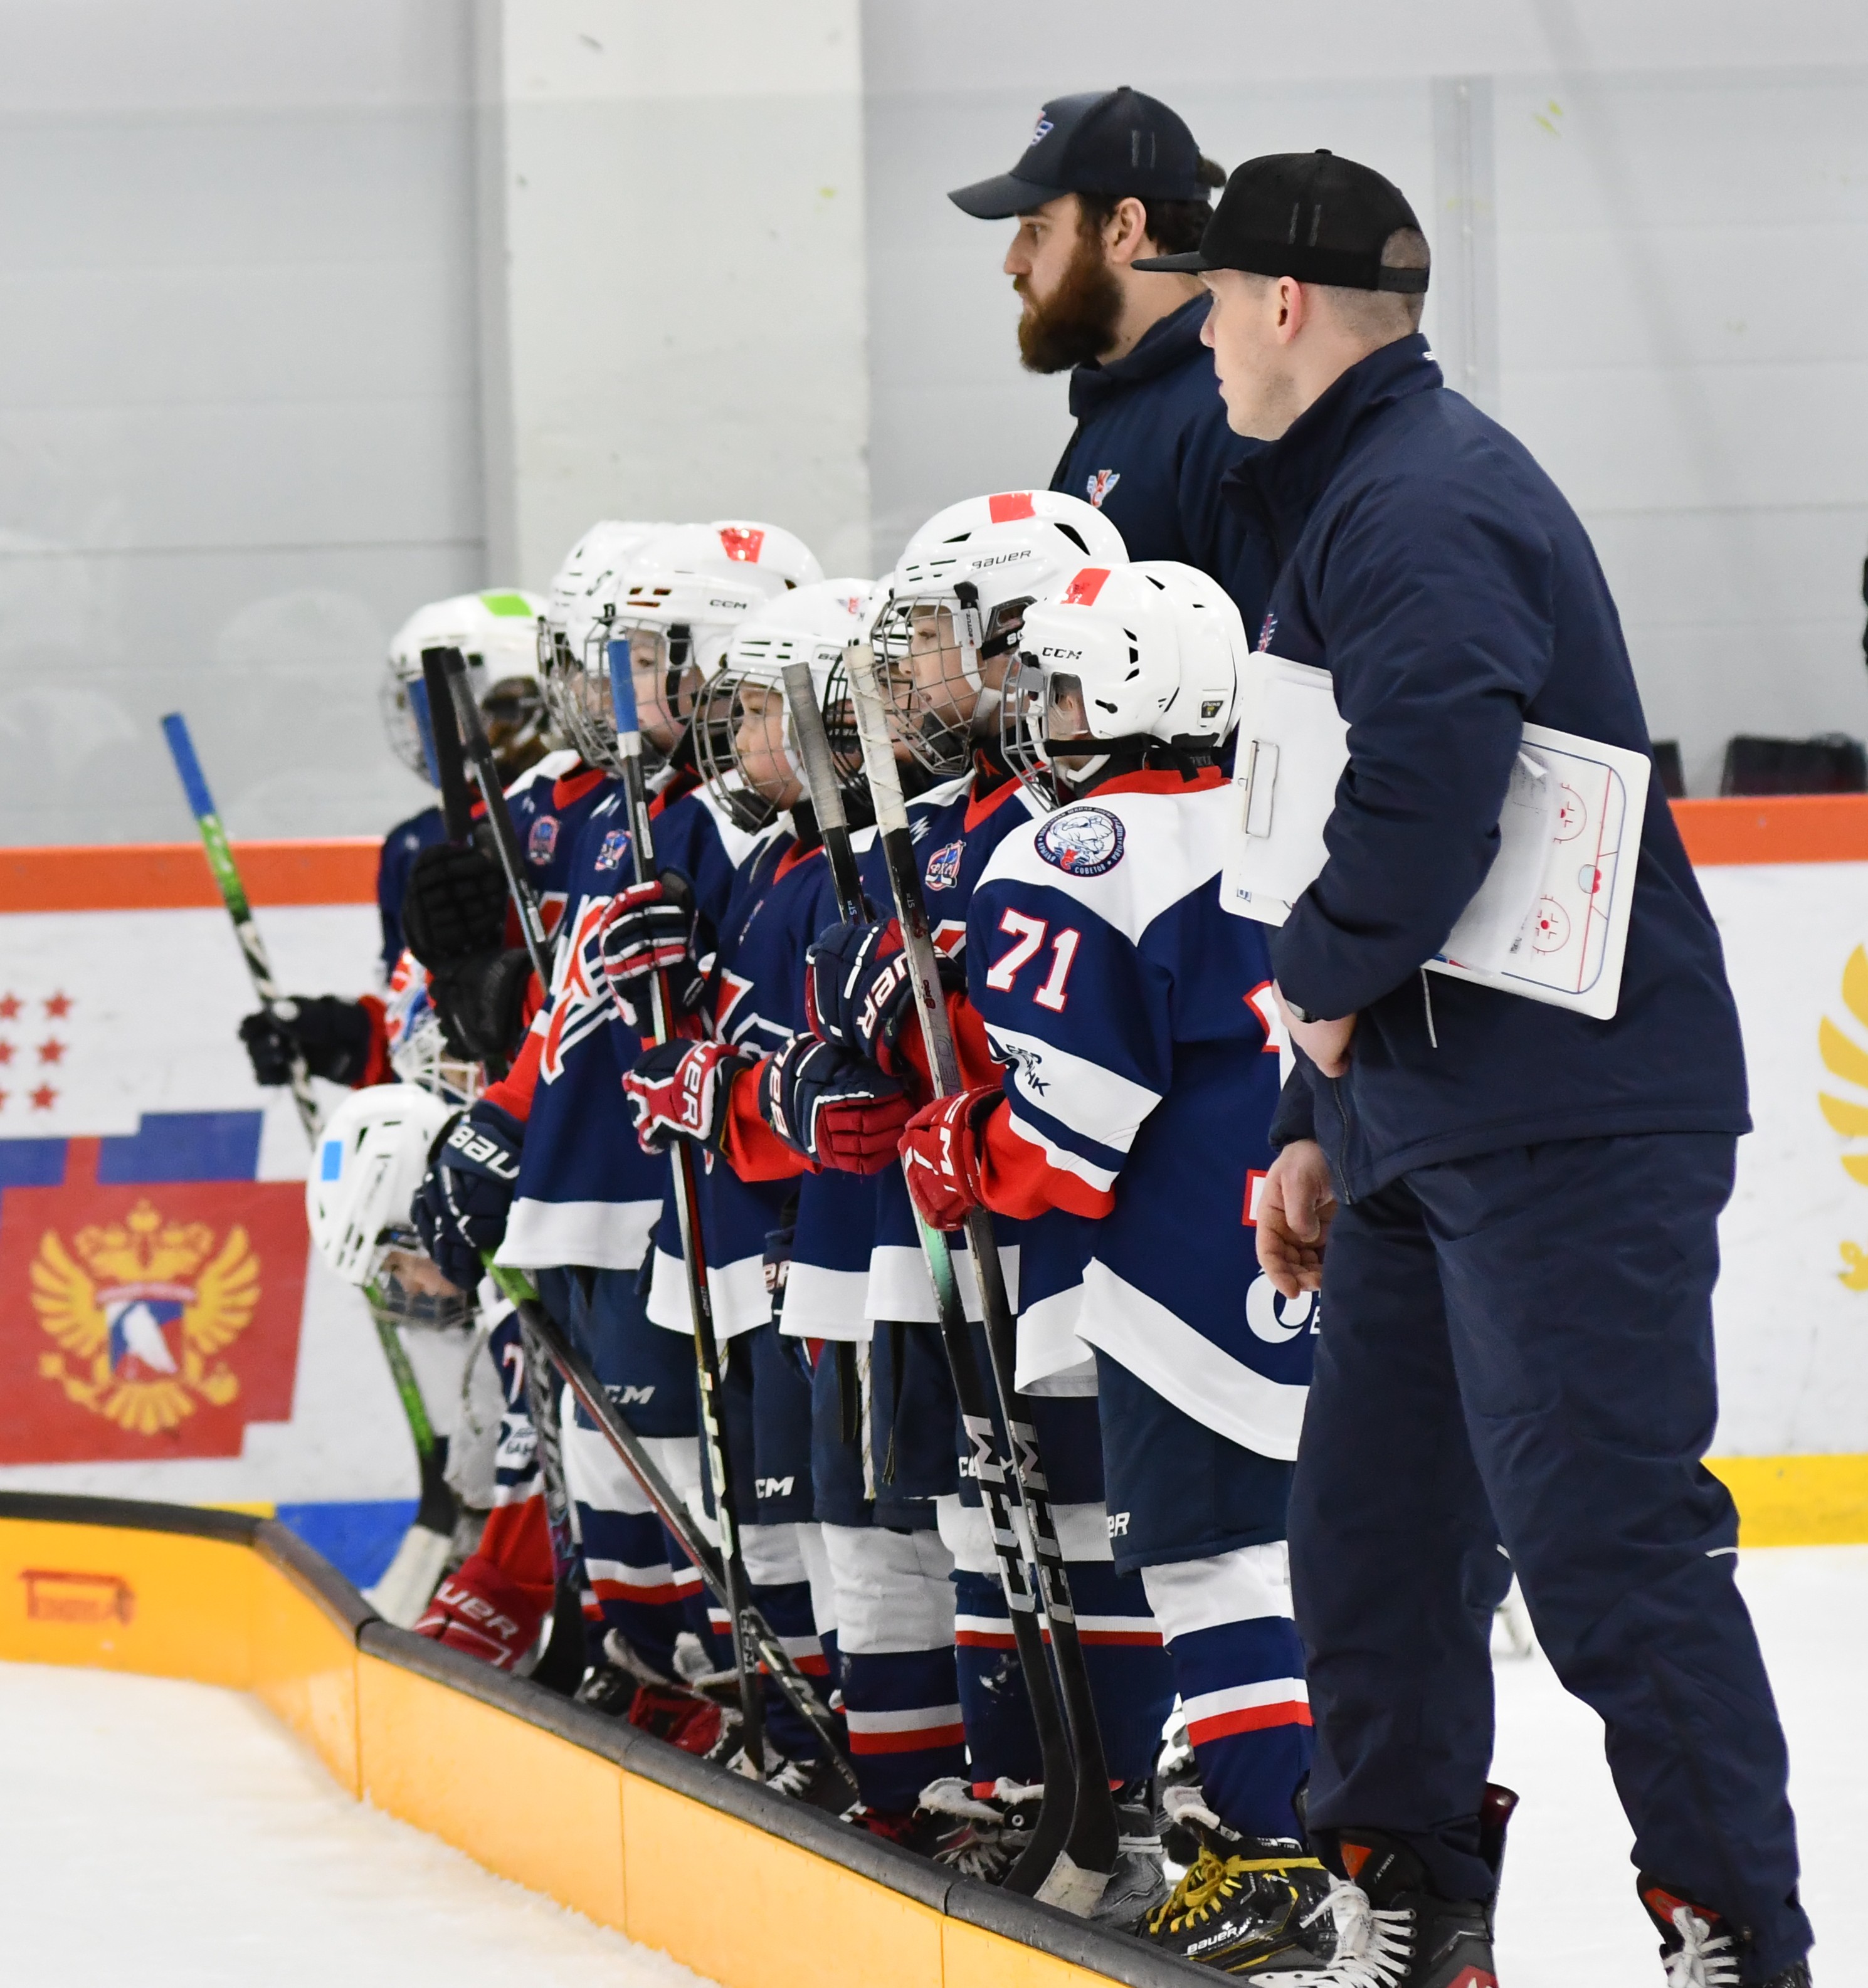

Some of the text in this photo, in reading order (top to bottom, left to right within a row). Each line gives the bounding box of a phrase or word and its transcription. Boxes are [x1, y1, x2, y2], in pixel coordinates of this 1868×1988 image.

[971, 550, 1032, 571] BAUER
[710, 599, 747, 610] CCM
[1042, 646, 1082, 660] CCM
[1074, 864, 1106, 875] СОВЕТОВ
[986, 907, 1082, 1014] 71
[962, 1414, 1037, 1614] CCM
[1008, 1419, 1074, 1624] CCM
[1186, 1926, 1238, 1955] BAUER
